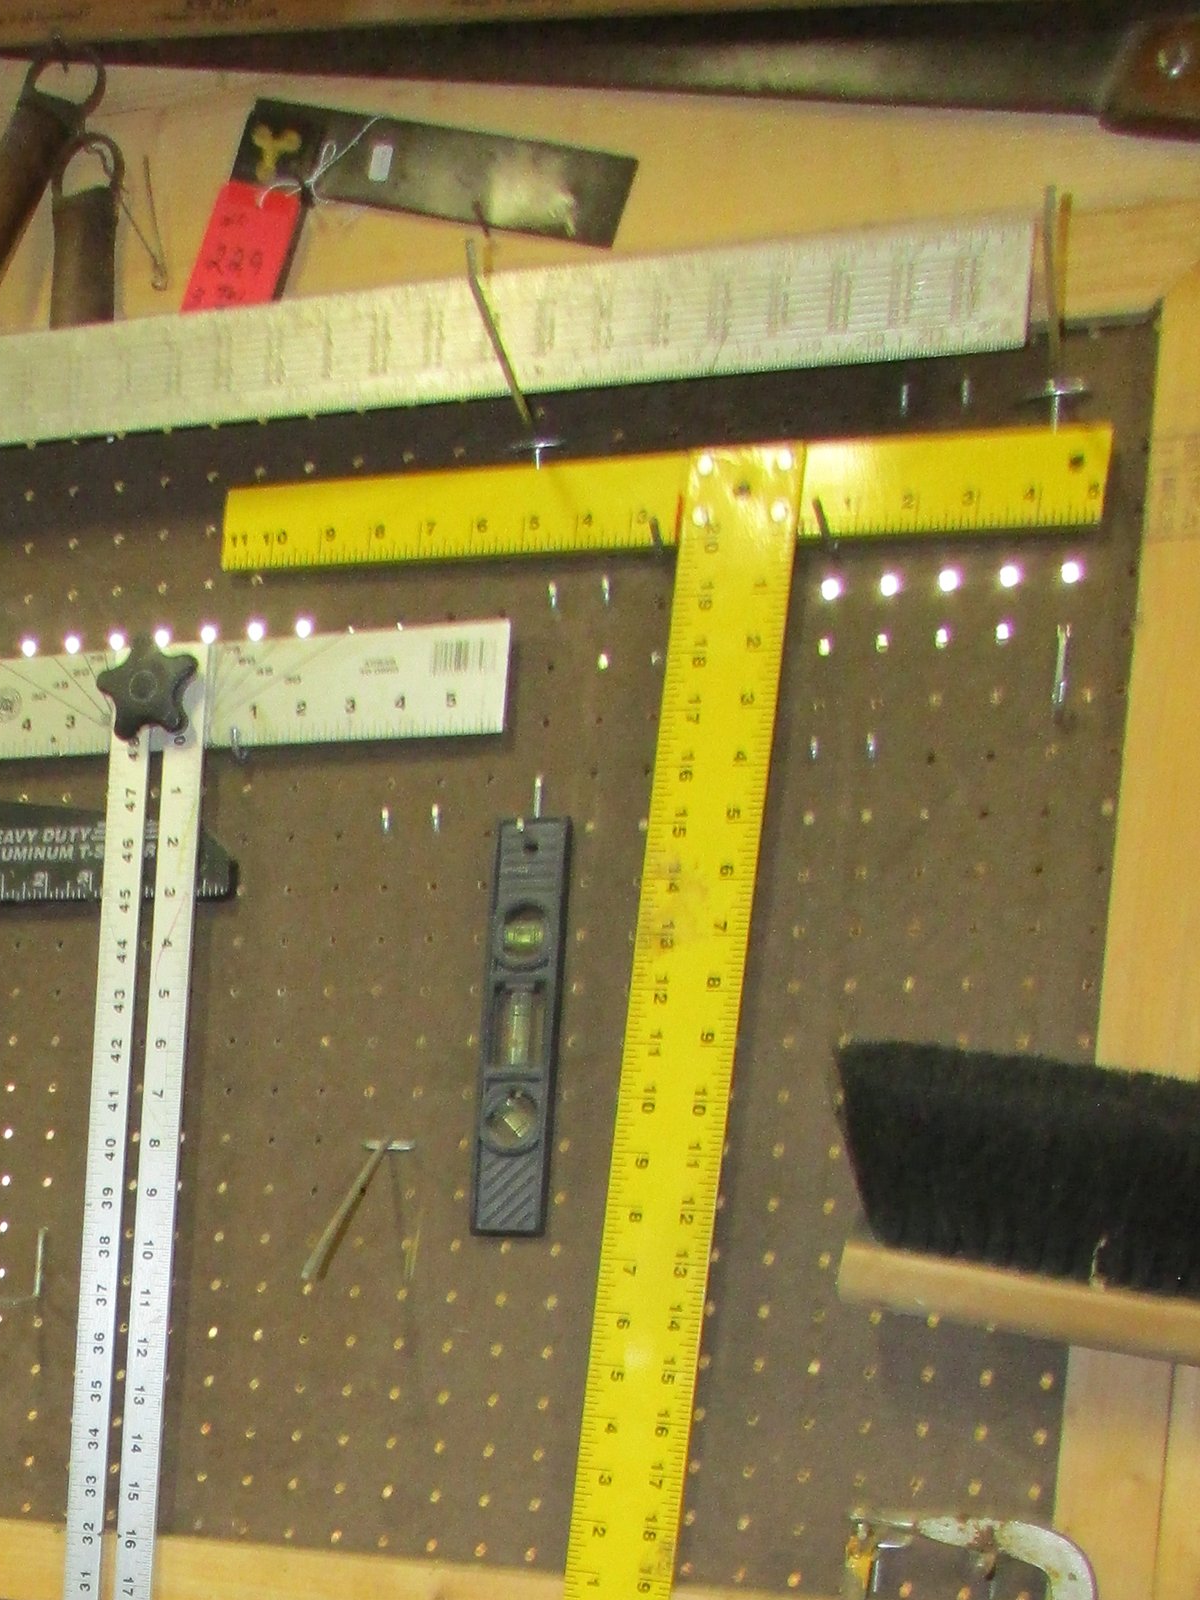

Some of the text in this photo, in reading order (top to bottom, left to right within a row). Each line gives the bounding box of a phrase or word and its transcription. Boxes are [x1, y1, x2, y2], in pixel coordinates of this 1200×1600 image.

[230, 514, 593, 547] 11 10 9 8 7 6 5 4
[22, 718, 32, 731] 4
[66, 715, 75, 729] 3
[251, 704, 257, 719] 1
[296, 701, 306, 716] 2
[346, 698, 356, 713] 3
[395, 695, 406, 710] 4
[446, 692, 456, 708] 5
[111, 1038, 123, 1063] 42
[155, 1039, 166, 1049] 6
[108, 1090, 119, 1112] 41
[152, 1089, 164, 1098] 7
[105, 1138, 116, 1161] 40
[150, 1139, 160, 1148] 8
[102, 1187, 114, 1209] 39
[147, 1188, 157, 1197] 9
[643, 921, 728, 1542] 7 8 9 10 11 12 13 14 15 16 17 18
[99, 1236, 110, 1258] 38
[143, 1240, 154, 1259] 10
[586, 974, 669, 1588] 12 11 10 9 8 7 6 5 4 3 2 1
[96, 1285, 108, 1306] 37
[140, 1289, 151, 1307] 11
[94, 1332, 105, 1354] 36
[136, 1338, 148, 1357] 12
[91, 1380, 102, 1402] 35
[134, 1386, 145, 1405] 13
[88, 1428, 99, 1450] 34
[131, 1435, 143, 1453] 14
[85, 1476, 97, 1497] 33
[128, 1482, 139, 1501] 15
[83, 1522, 94, 1545] 32
[125, 1530, 136, 1549] 16
[80, 1571, 91, 1591] 31
[122, 1577, 134, 1596] 17
